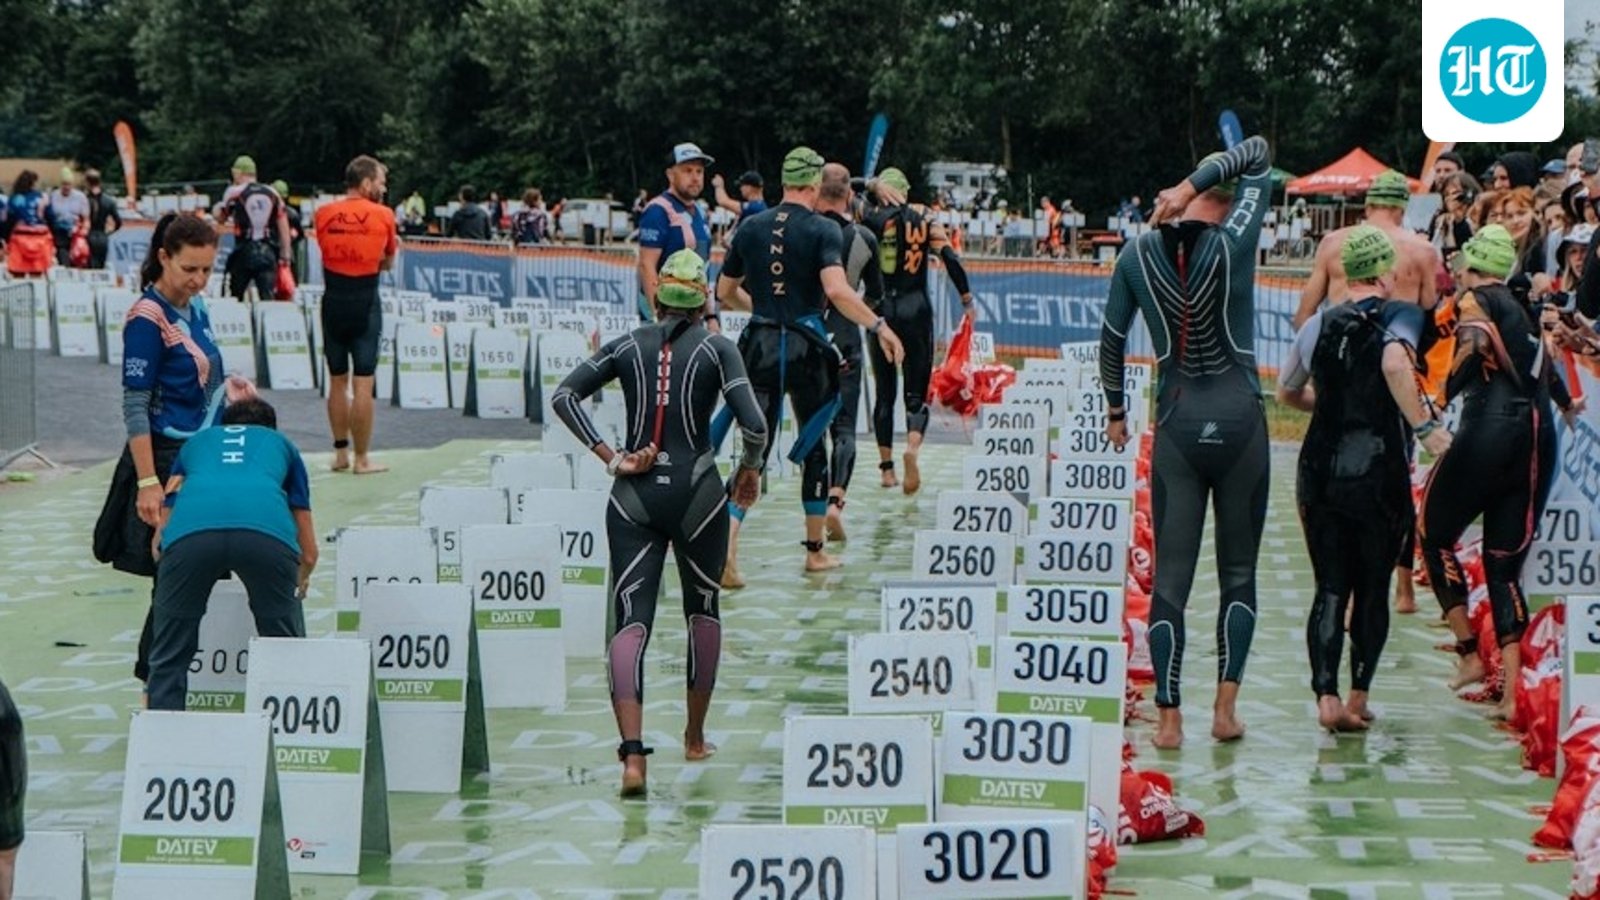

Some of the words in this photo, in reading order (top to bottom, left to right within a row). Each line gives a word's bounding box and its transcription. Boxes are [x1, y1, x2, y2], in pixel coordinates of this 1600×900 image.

[769, 212, 789, 295] RYZON
[403, 345, 438, 358] 1660
[480, 351, 514, 364] 1650
[1070, 430, 1126, 454] 309
[975, 465, 1030, 492] 2580
[1065, 463, 1127, 491] 3080
[952, 505, 1013, 533] 2570
[1050, 501, 1118, 531] 3070
[1533, 508, 1580, 542] 70
[929, 545, 996, 577] 2560
[1038, 541, 1114, 574] 3060
[1536, 550, 1600, 586] 356
[480, 570, 545, 601] 2060
[491, 610, 536, 624] DATEV
[899, 596, 974, 632] 2550
[1025, 588, 1109, 624] 3050
[377, 634, 450, 669] 2050
[1013, 642, 1109, 685] 3040
[383, 680, 435, 695] DATEV
[869, 655, 953, 697] 2540
[186, 693, 236, 708] DATEV
[261, 695, 342, 735] 2040
[1029, 695, 1088, 713] DATEV
[276, 747, 331, 764] DATEV
[962, 716, 1072, 766] 3030
[806, 742, 903, 789] 2530
[143, 777, 236, 822] 2030
[980, 779, 1047, 799] DATEV
[823, 807, 889, 825] DATEV
[156, 838, 219, 856] DATEV
[922, 827, 1051, 884] 3020
[730, 856, 845, 900] 2520
